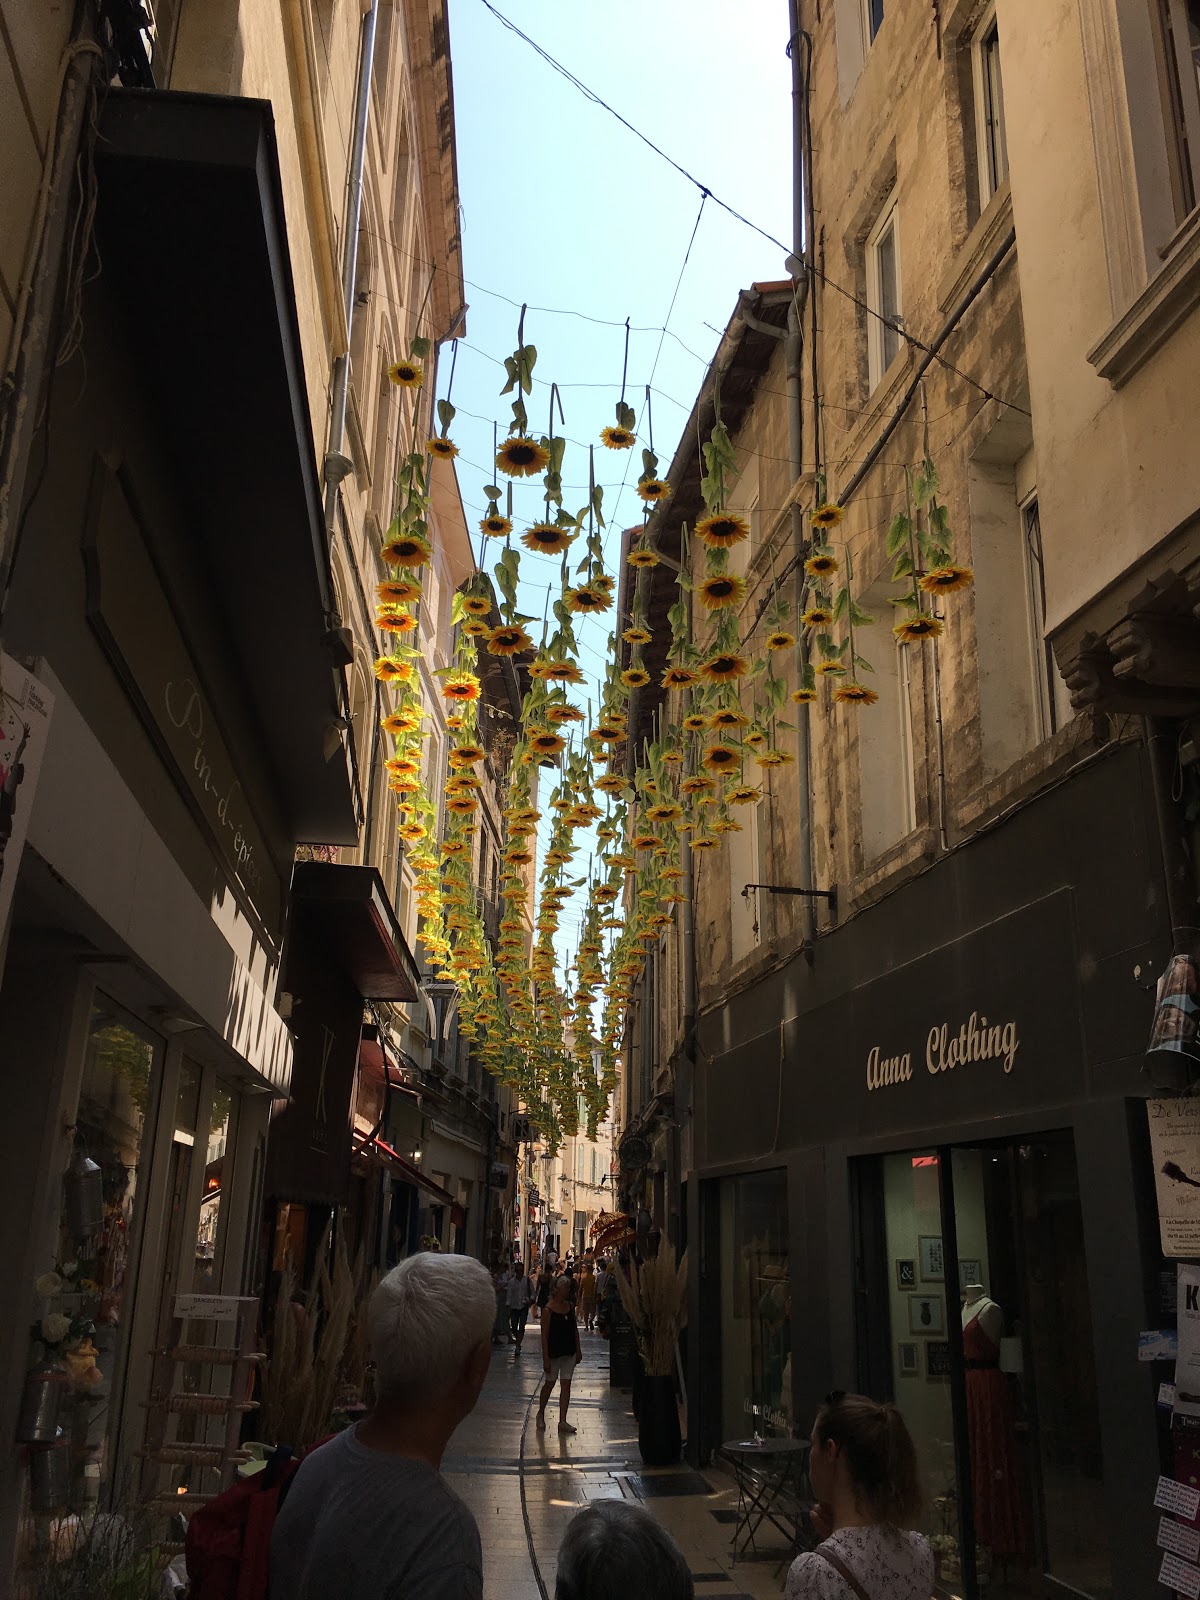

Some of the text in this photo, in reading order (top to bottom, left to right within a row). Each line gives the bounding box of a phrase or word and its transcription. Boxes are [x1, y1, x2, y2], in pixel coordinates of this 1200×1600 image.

[867, 1011, 1020, 1090] Anna Clothing
[1152, 1103, 1171, 1118] De
